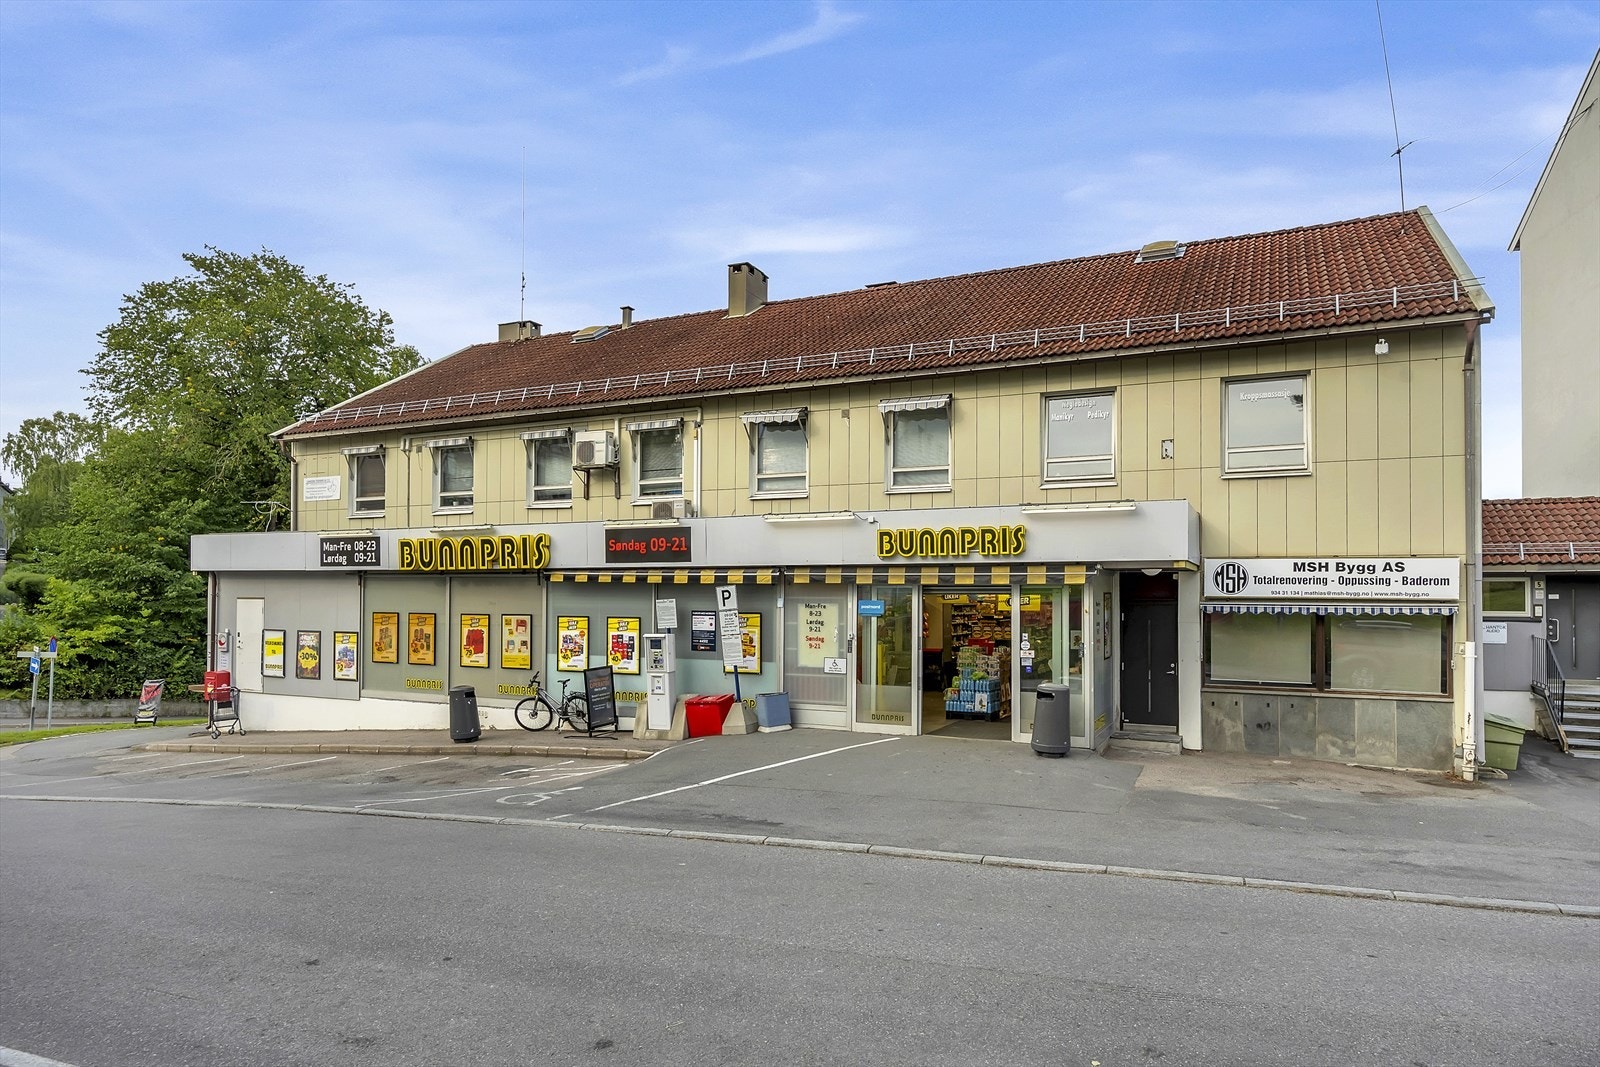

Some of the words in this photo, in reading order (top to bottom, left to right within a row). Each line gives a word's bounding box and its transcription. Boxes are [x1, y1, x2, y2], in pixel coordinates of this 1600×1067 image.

[1087, 409, 1109, 419] Pedikyr
[323, 541, 351, 551] Man-Fre
[354, 540, 376, 551] 08-23
[609, 539, 646, 554] Søndag
[650, 537, 687, 551] 09-21
[878, 525, 1025, 557] BUNNPRIS
[323, 553, 347, 565] Lørdag
[354, 552, 376, 563] 09-21
[398, 534, 550, 571] BUNNPRIS
[1293, 562, 1329, 573] MSH
[1335, 562, 1376, 574] Bygg
[1382, 562, 1406, 573] AS
[1214, 563, 1247, 594] MSH
[1253, 575, 1328, 587] Totalrenovering
[1338, 575, 1391, 586] Oppussing
[1402, 576, 1450, 586] Baderom
[721, 589, 731, 607] P
[299, 652, 317, 661] -30%
[406, 679, 444, 689] BUNNPRIS
[871, 713, 904, 722] BUNNPRIS
